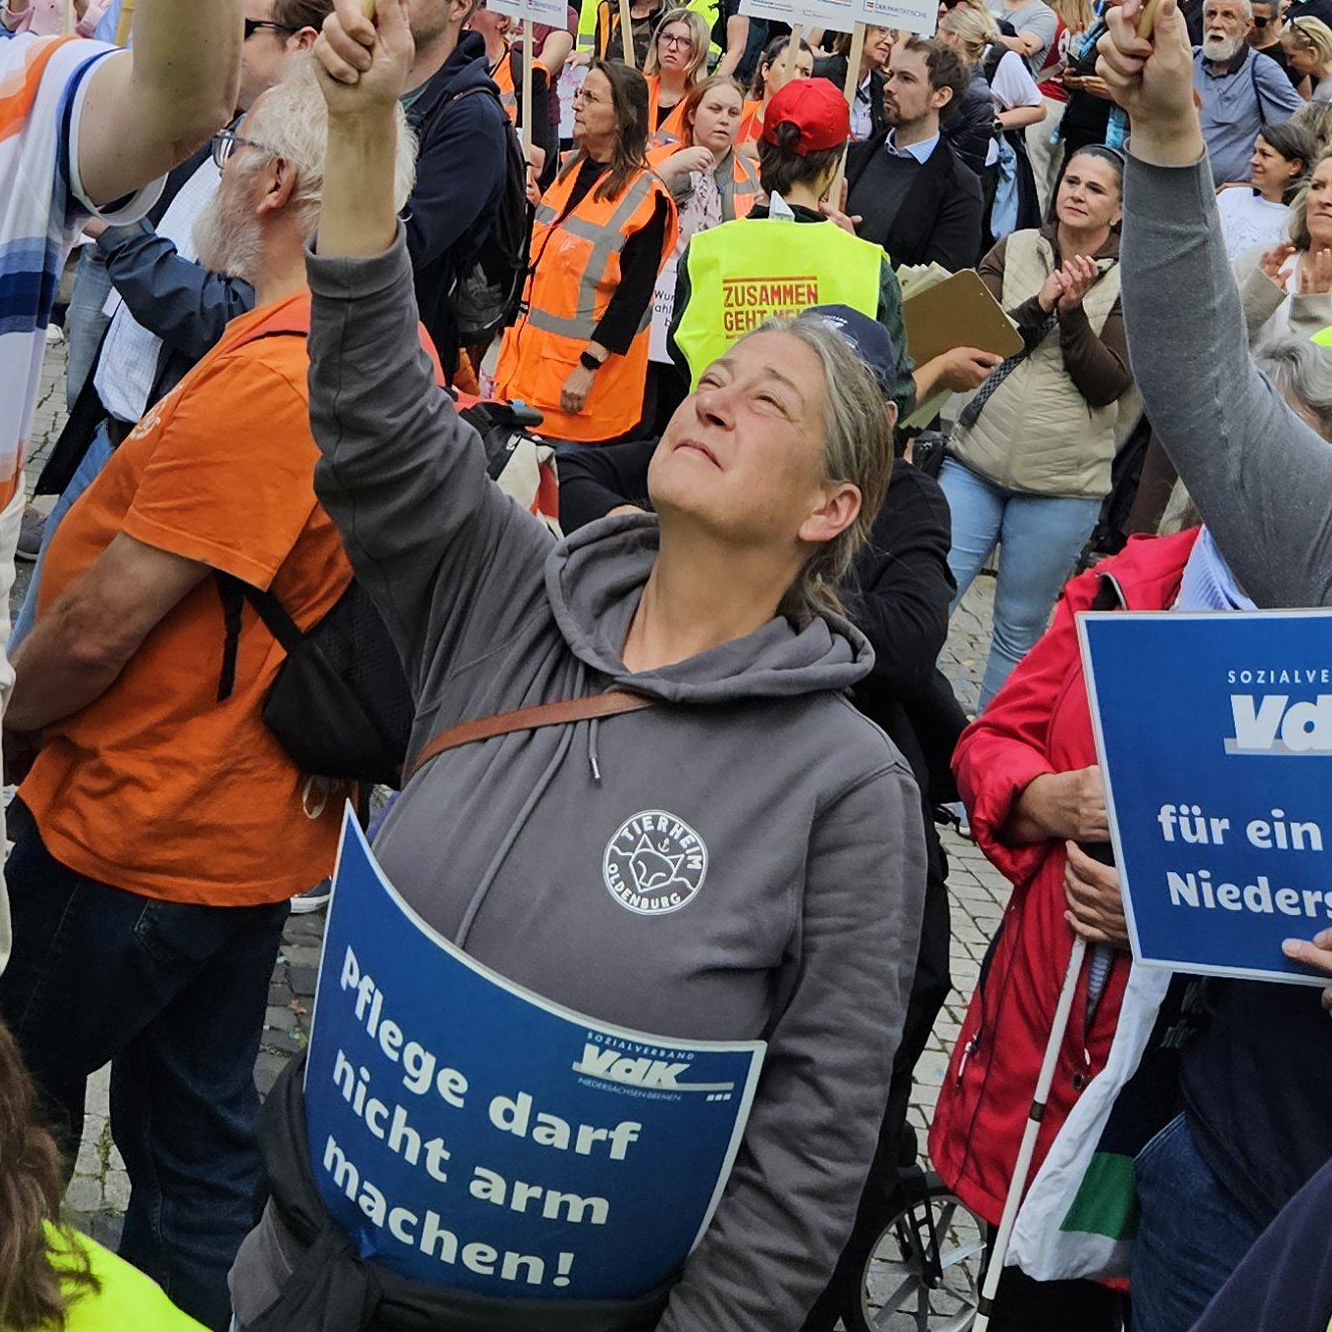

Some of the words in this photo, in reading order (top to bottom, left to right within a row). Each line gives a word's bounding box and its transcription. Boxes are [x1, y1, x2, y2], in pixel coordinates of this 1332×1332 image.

[723, 282, 818, 308] ZUSAMMEN
[621, 815, 703, 871] TIERHEIM
[1157, 804, 1231, 846] für
[1244, 807, 1324, 853] ein
[607, 862, 682, 910] OLDENBURG
[339, 944, 470, 1110] Pflege
[487, 1090, 643, 1162] darf
[578, 1042, 692, 1090] VdK
[586, 1030, 696, 1062] SOZIALVERBAND
[333, 1048, 453, 1185] nicht
[468, 1164, 612, 1227] arm
[322, 1134, 576, 1288] machen!
